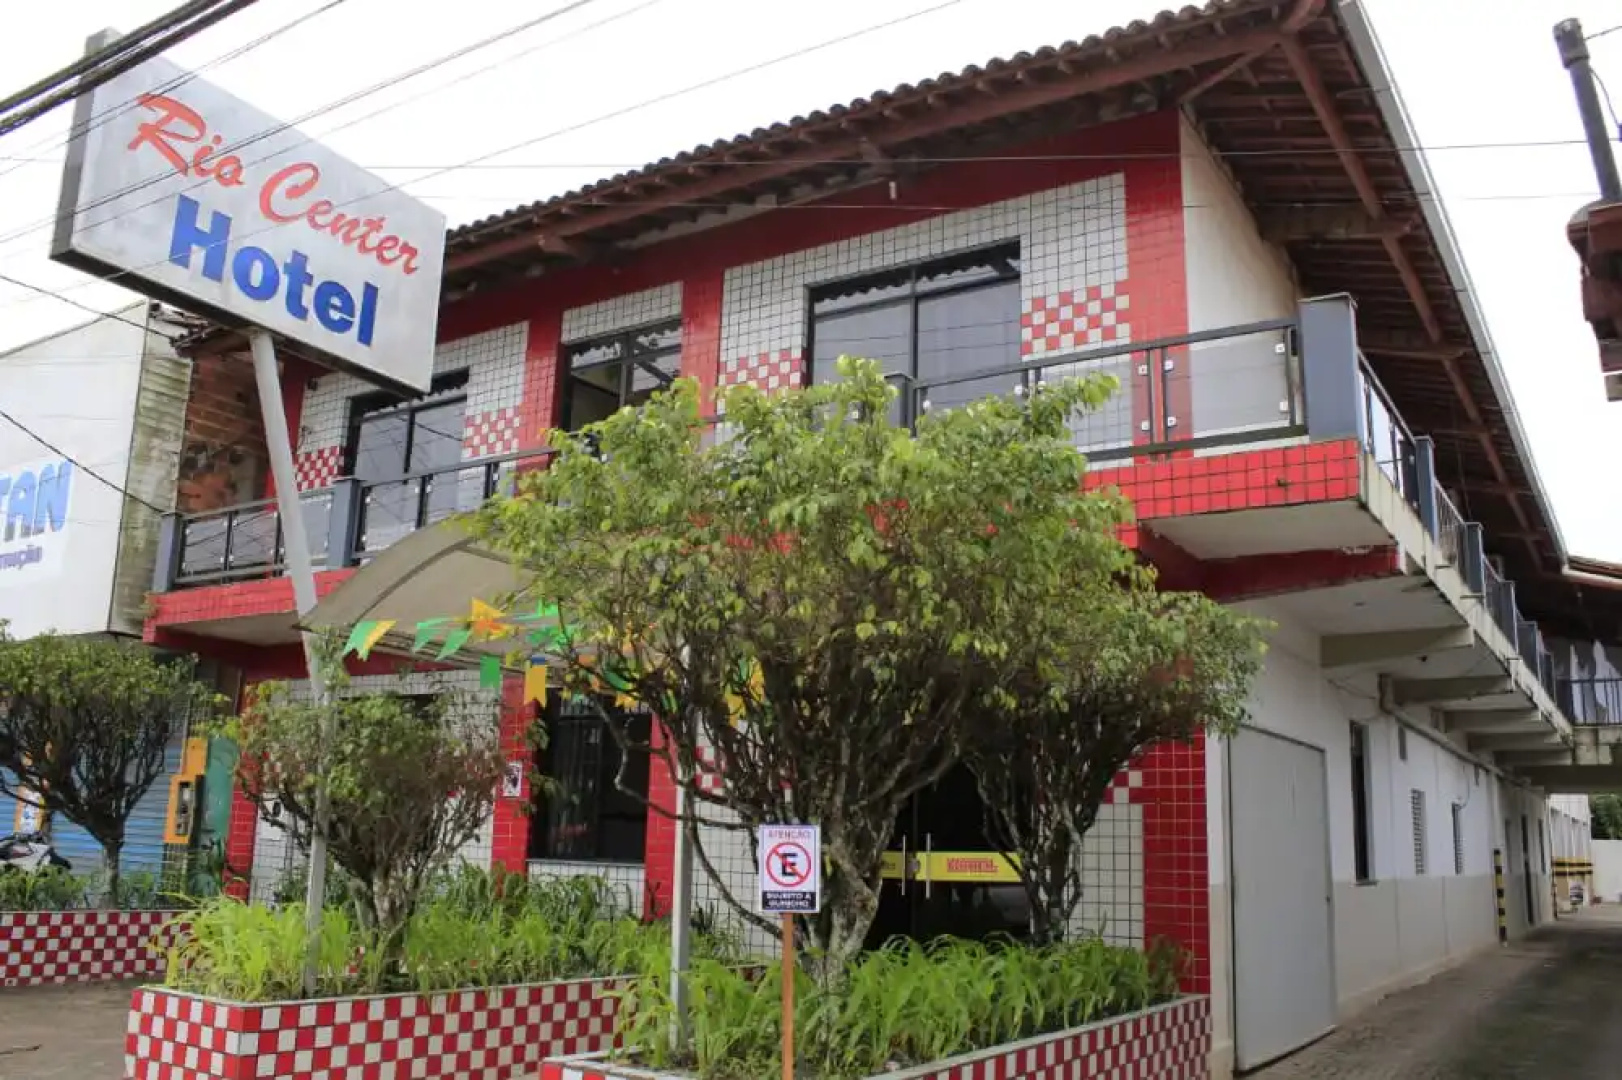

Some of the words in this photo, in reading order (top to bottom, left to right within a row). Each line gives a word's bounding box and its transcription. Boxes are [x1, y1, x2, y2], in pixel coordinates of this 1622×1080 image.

[128, 93, 245, 186] Rio
[260, 161, 420, 275] Center
[169, 194, 379, 347] Hotel
